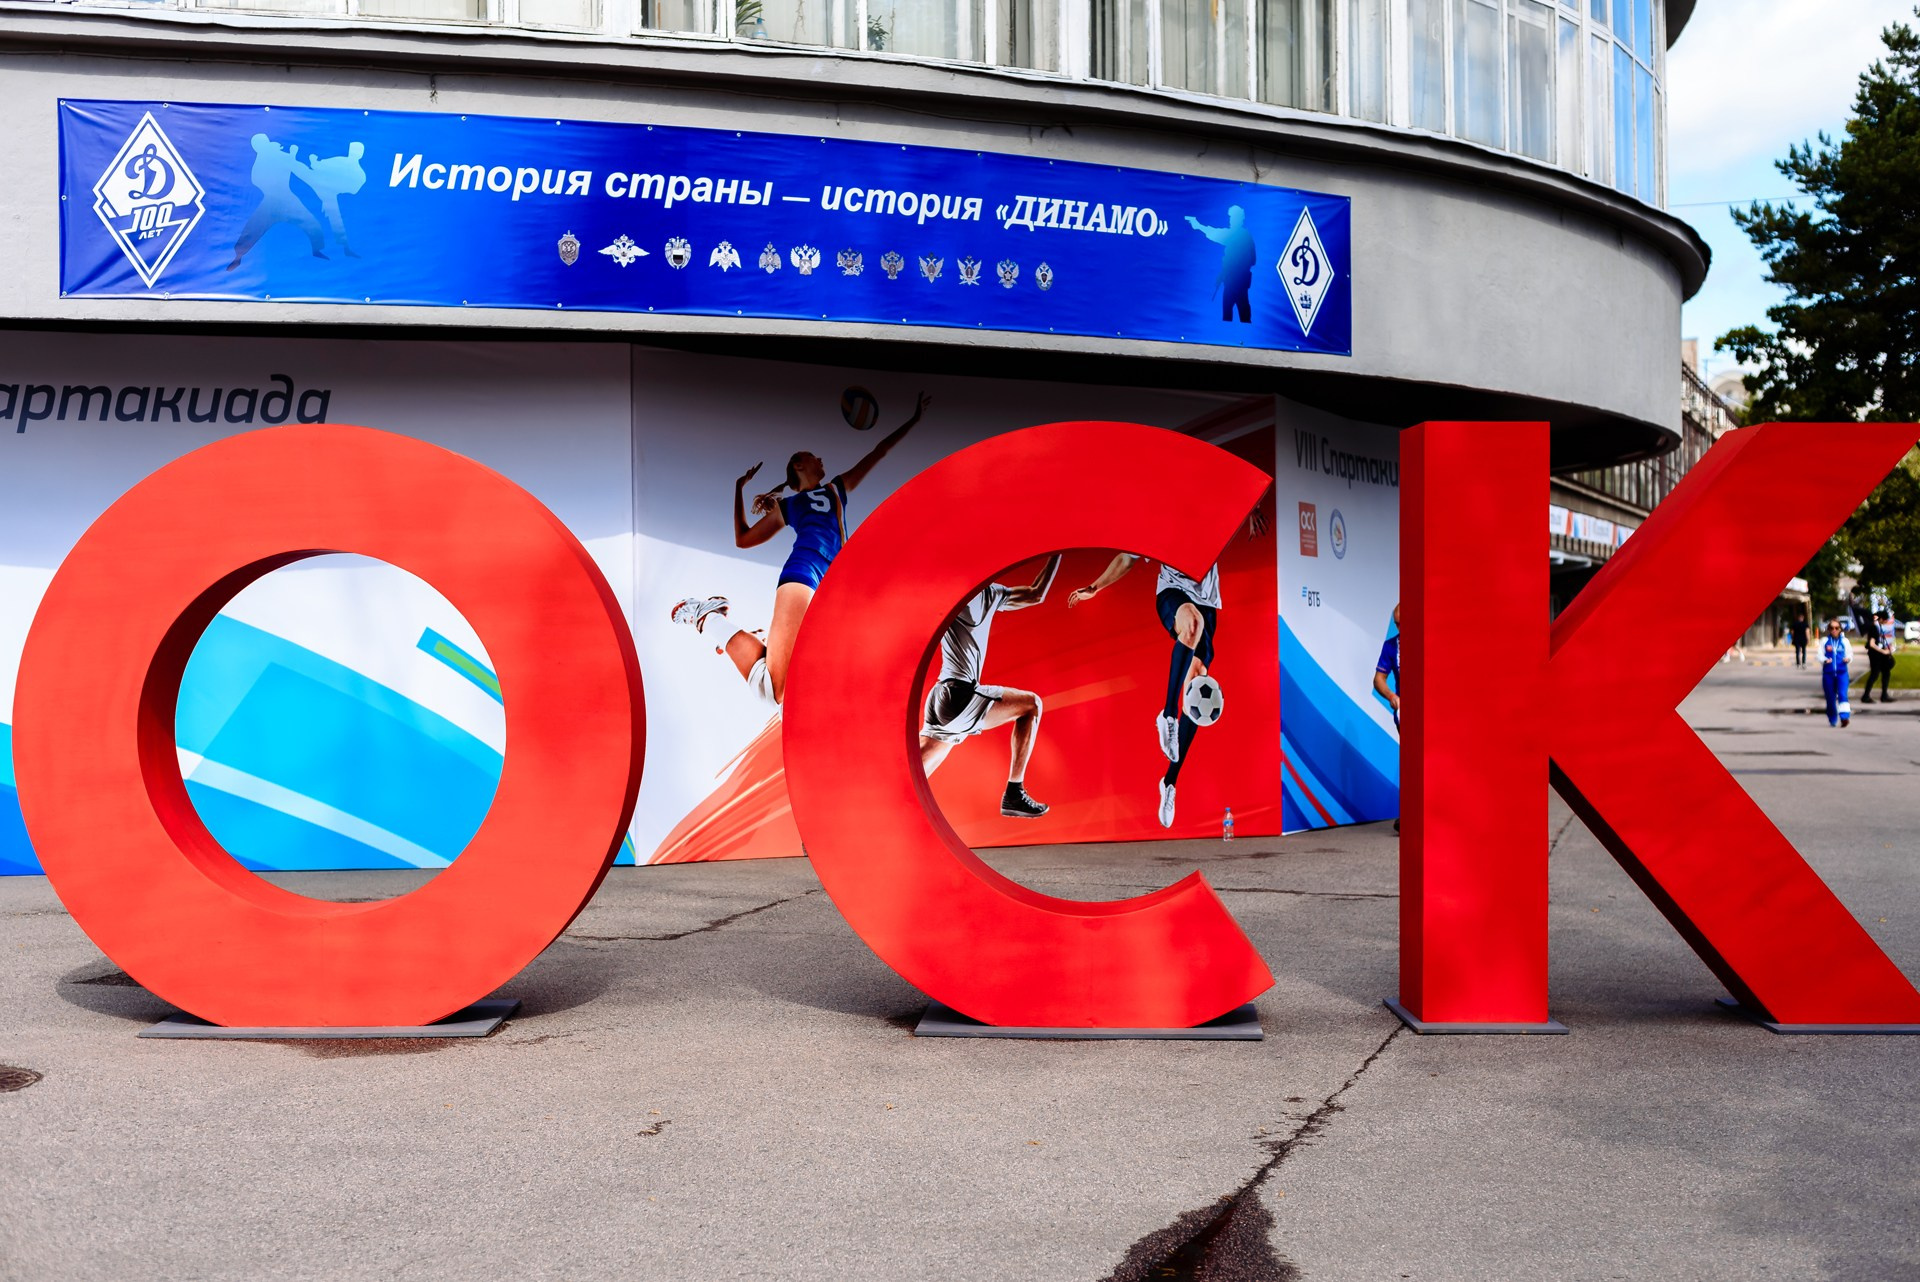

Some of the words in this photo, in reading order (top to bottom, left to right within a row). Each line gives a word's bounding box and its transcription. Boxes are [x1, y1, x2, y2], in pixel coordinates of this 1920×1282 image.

[389, 153, 593, 201] История
[604, 171, 774, 209] страны
[821, 185, 983, 225] история
[996, 195, 1170, 237] «ДИНАМО»
[132, 203, 174, 232] 100
[138, 228, 164, 240] ЛЕТ
[1294, 428, 1317, 472] VIII
[1321, 437, 1399, 490] Спартаки
[806, 487, 831, 513] 5
[1301, 511, 1315, 532] ОСК
[1308, 591, 1320, 607] ВТБ
